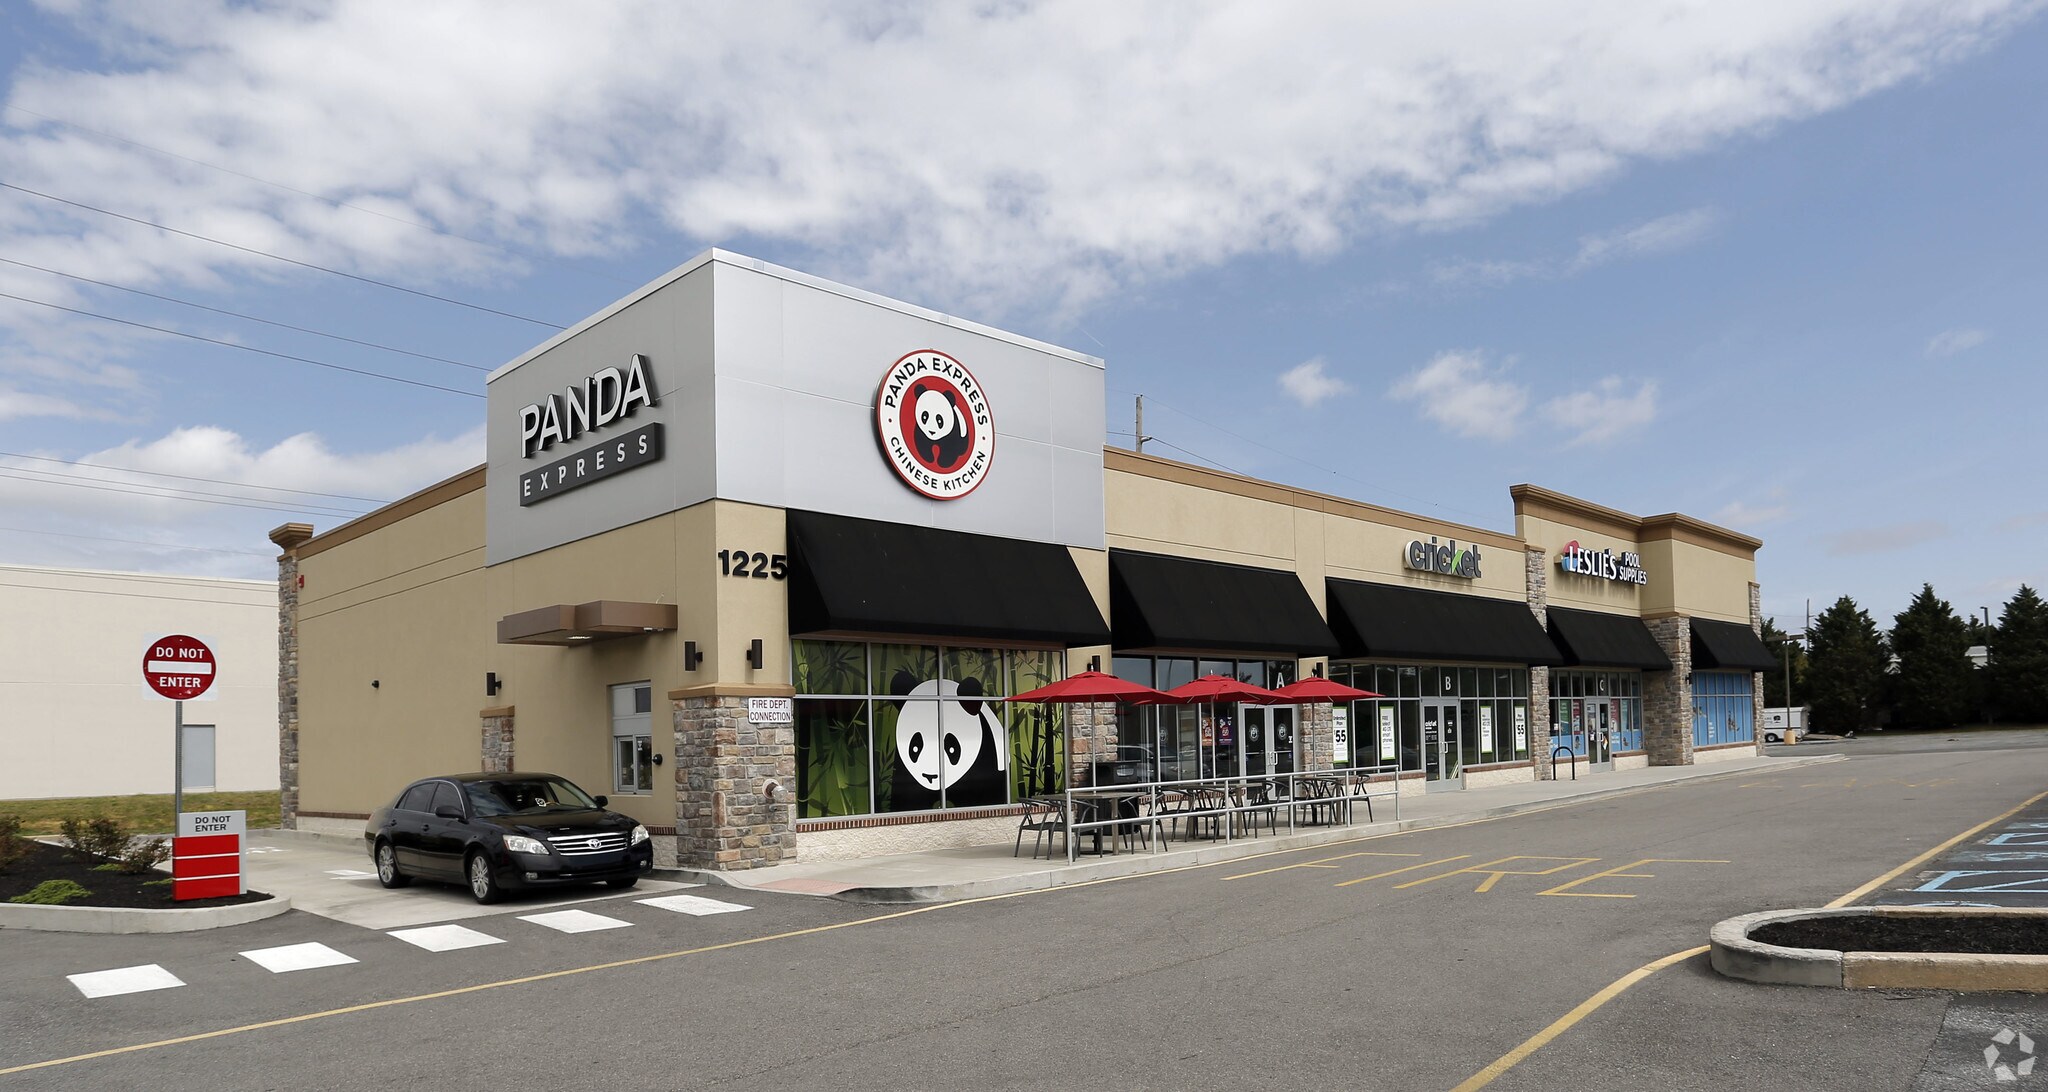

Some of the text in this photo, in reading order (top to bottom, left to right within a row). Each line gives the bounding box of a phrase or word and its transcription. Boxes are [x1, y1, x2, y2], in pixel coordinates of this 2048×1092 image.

[885, 357, 988, 426] PANDA EXPRESS
[519, 353, 654, 459] PANDA
[523, 434, 648, 497] EXPRESS
[890, 436, 986, 491] CHINESE KITCHEN
[717, 549, 788, 580] 1225
[1406, 536, 1482, 579] cricket
[1568, 545, 1618, 581] LESLIE'S
[1624, 551, 1641, 568] POOL
[1619, 565, 1647, 585] SUPPLIES
[156, 646, 205, 659] DO NOT
[159, 676, 201, 688] ENTER
[1276, 672, 1285, 689] A
[1445, 676, 1451, 691] B
[752, 699, 789, 709] FIRE DEPT.
[750, 711, 791, 721] CONNECTION
[194, 815, 232, 825] DO NOT
[194, 823, 227, 833] ENTER
[1219, 852, 1732, 899] FIRE
